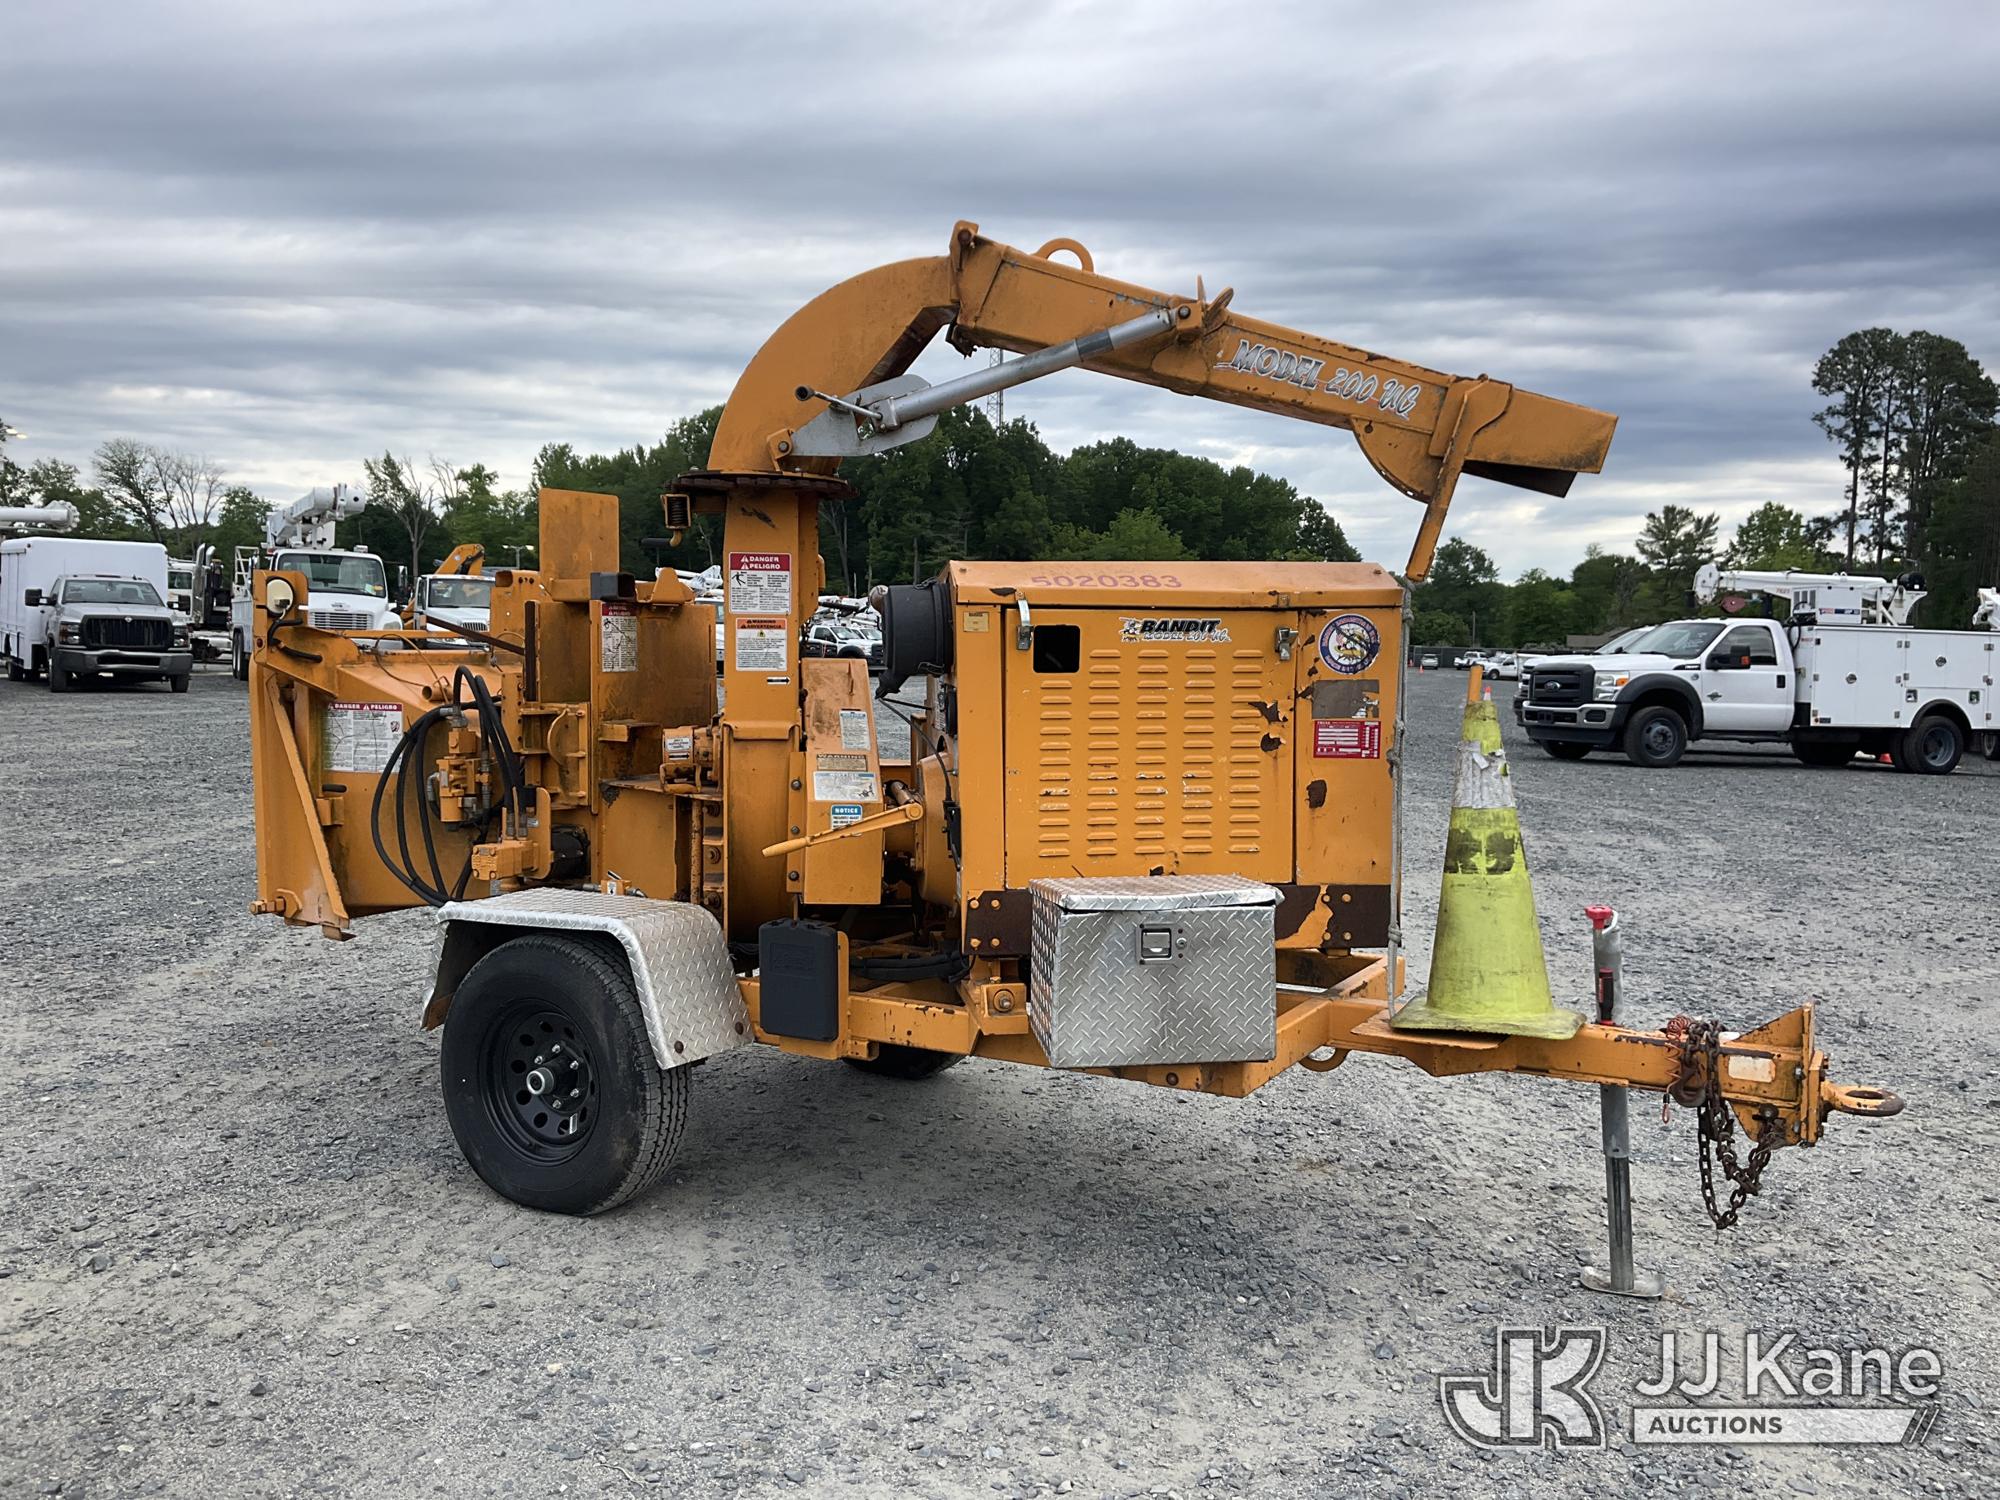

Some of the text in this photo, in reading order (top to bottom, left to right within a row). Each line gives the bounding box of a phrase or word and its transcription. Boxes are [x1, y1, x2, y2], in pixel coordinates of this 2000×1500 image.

[1229, 339, 1325, 390] MODEL
[1325, 367, 1378, 403] 200
[1031, 575, 1183, 589] 5020383
[1140, 619, 1221, 634] BANDIT
